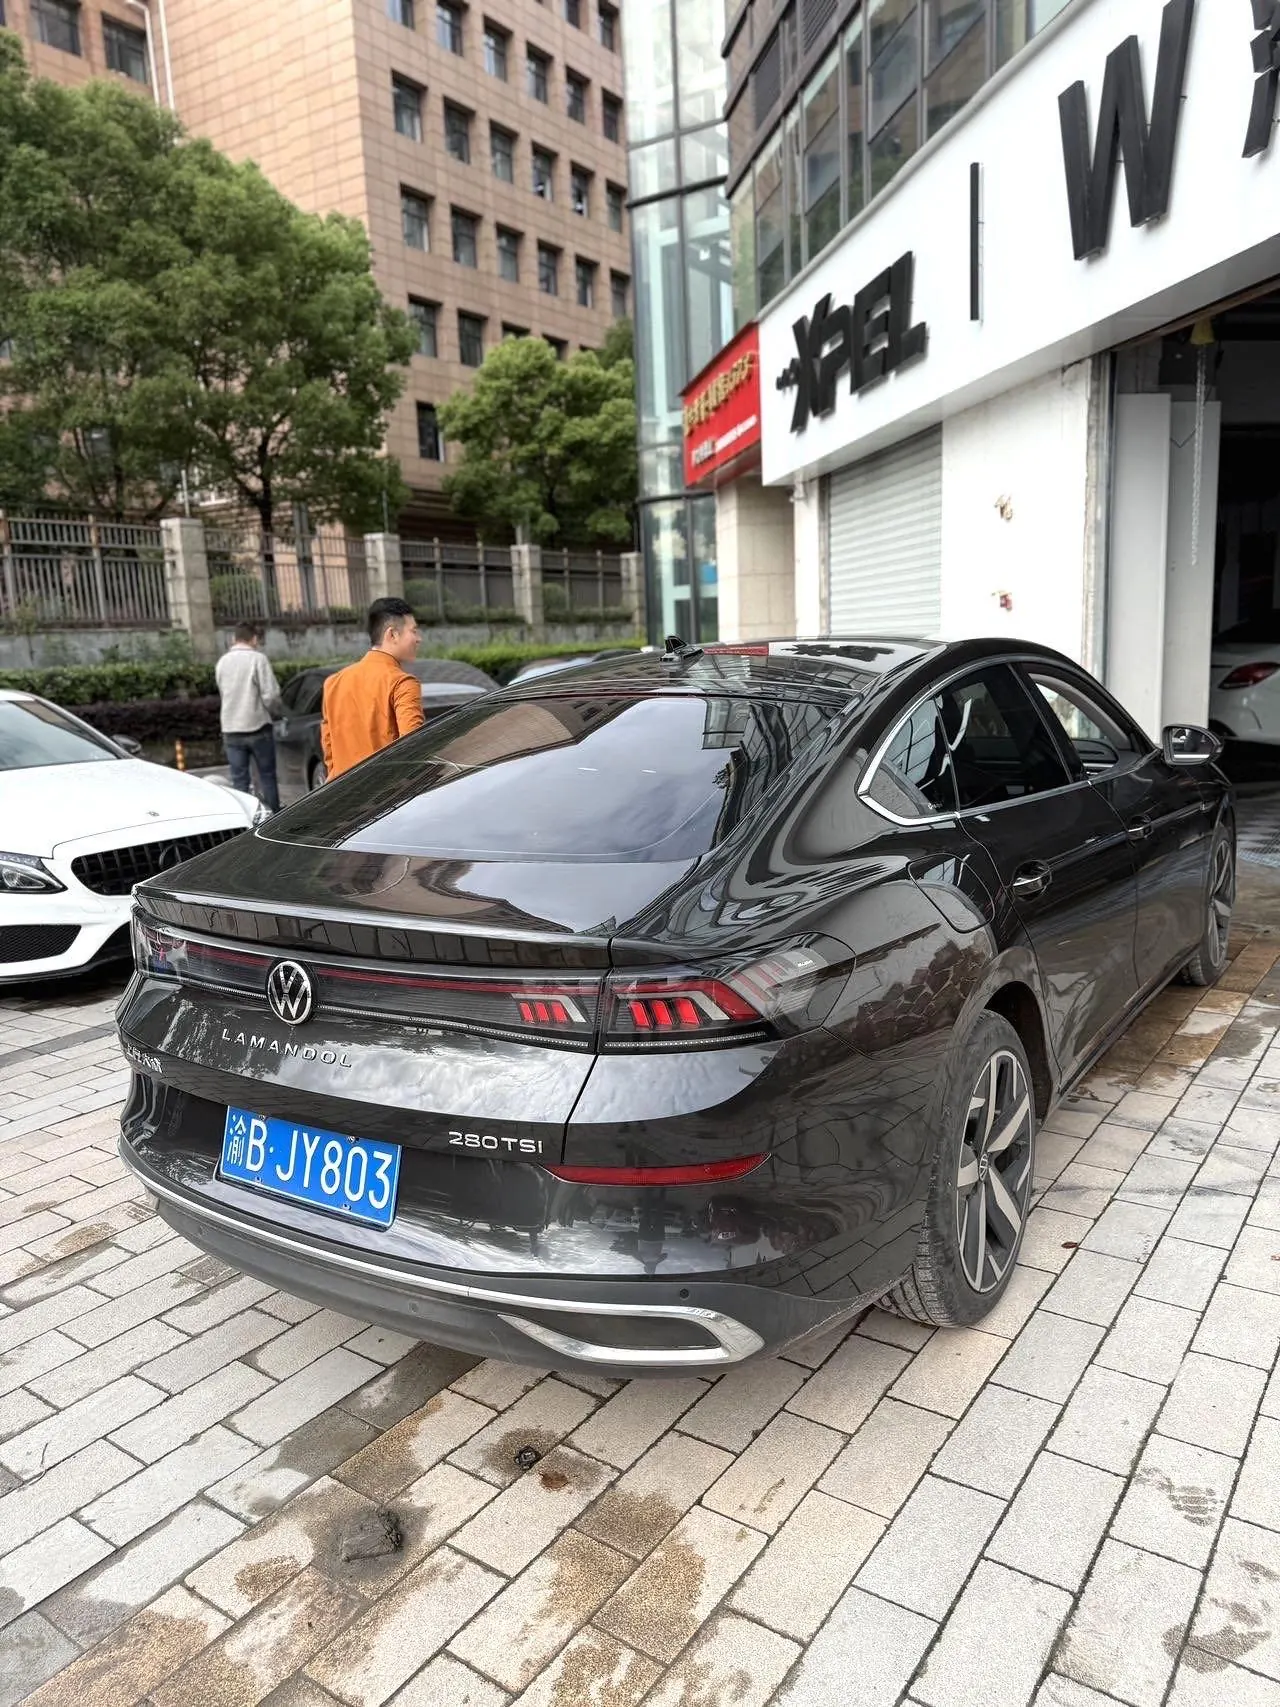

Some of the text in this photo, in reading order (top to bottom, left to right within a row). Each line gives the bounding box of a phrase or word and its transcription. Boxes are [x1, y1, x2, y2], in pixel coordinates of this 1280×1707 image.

[777, 251, 927, 433] XPEL
[221, 1028, 353, 1068] LAMANDOL
[448, 1131, 543, 1154] 280TSI
